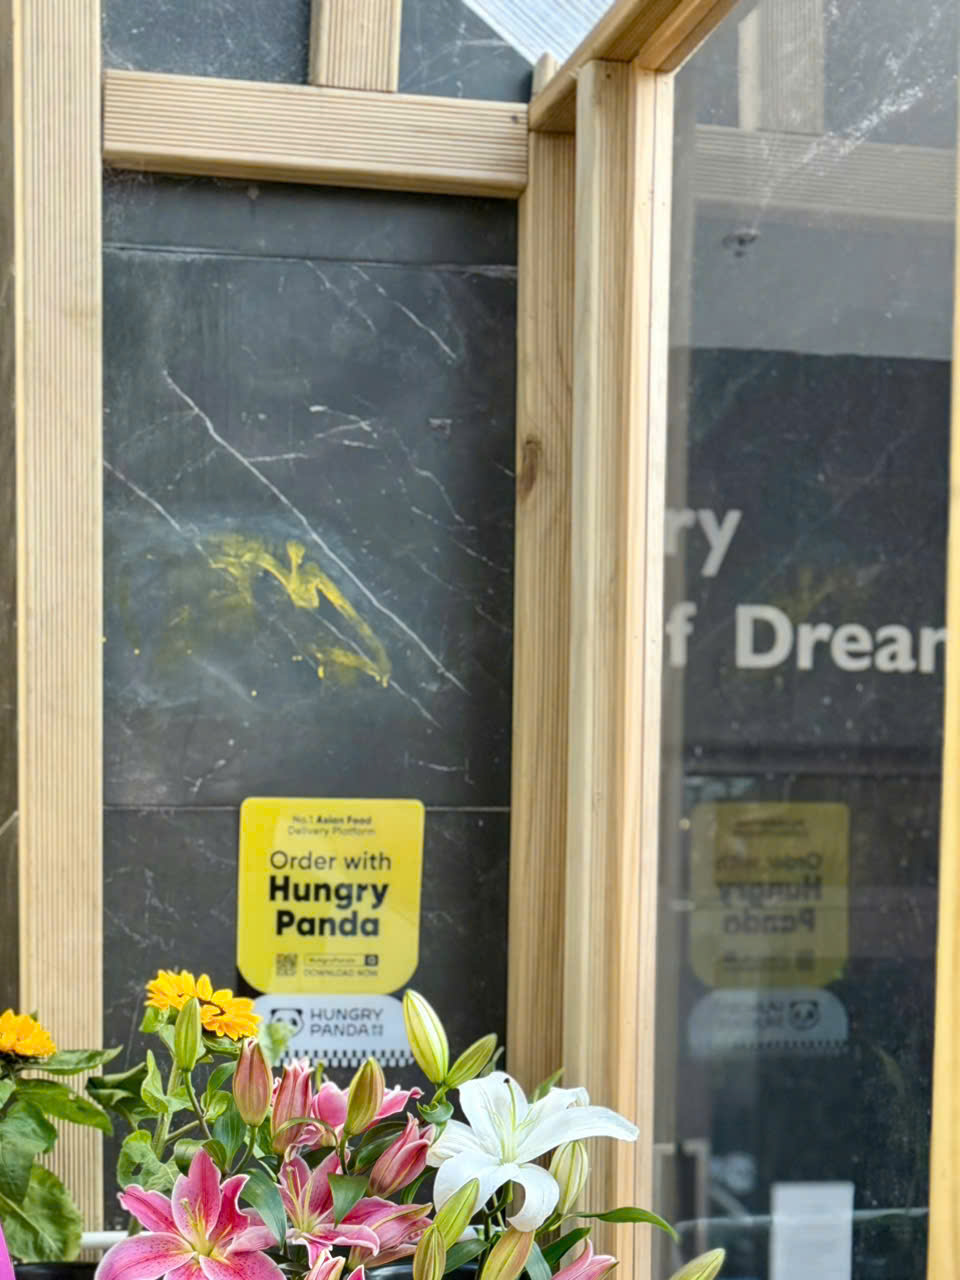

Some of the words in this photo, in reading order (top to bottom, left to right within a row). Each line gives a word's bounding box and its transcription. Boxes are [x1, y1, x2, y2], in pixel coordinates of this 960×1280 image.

[664, 508, 742, 578] ry
[665, 602, 698, 669] f
[315, 815, 344, 825] Asian
[346, 815, 372, 825] Food
[288, 825, 330, 837] Delivery
[332, 825, 376, 837] Platform
[270, 851, 336, 870] Order
[344, 851, 392, 870] with
[269, 875, 389, 909] Hungry
[276, 910, 380, 936] Panda
[310, 1008, 384, 1020] HUNGRY
[310, 1023, 369, 1036] PANDA
